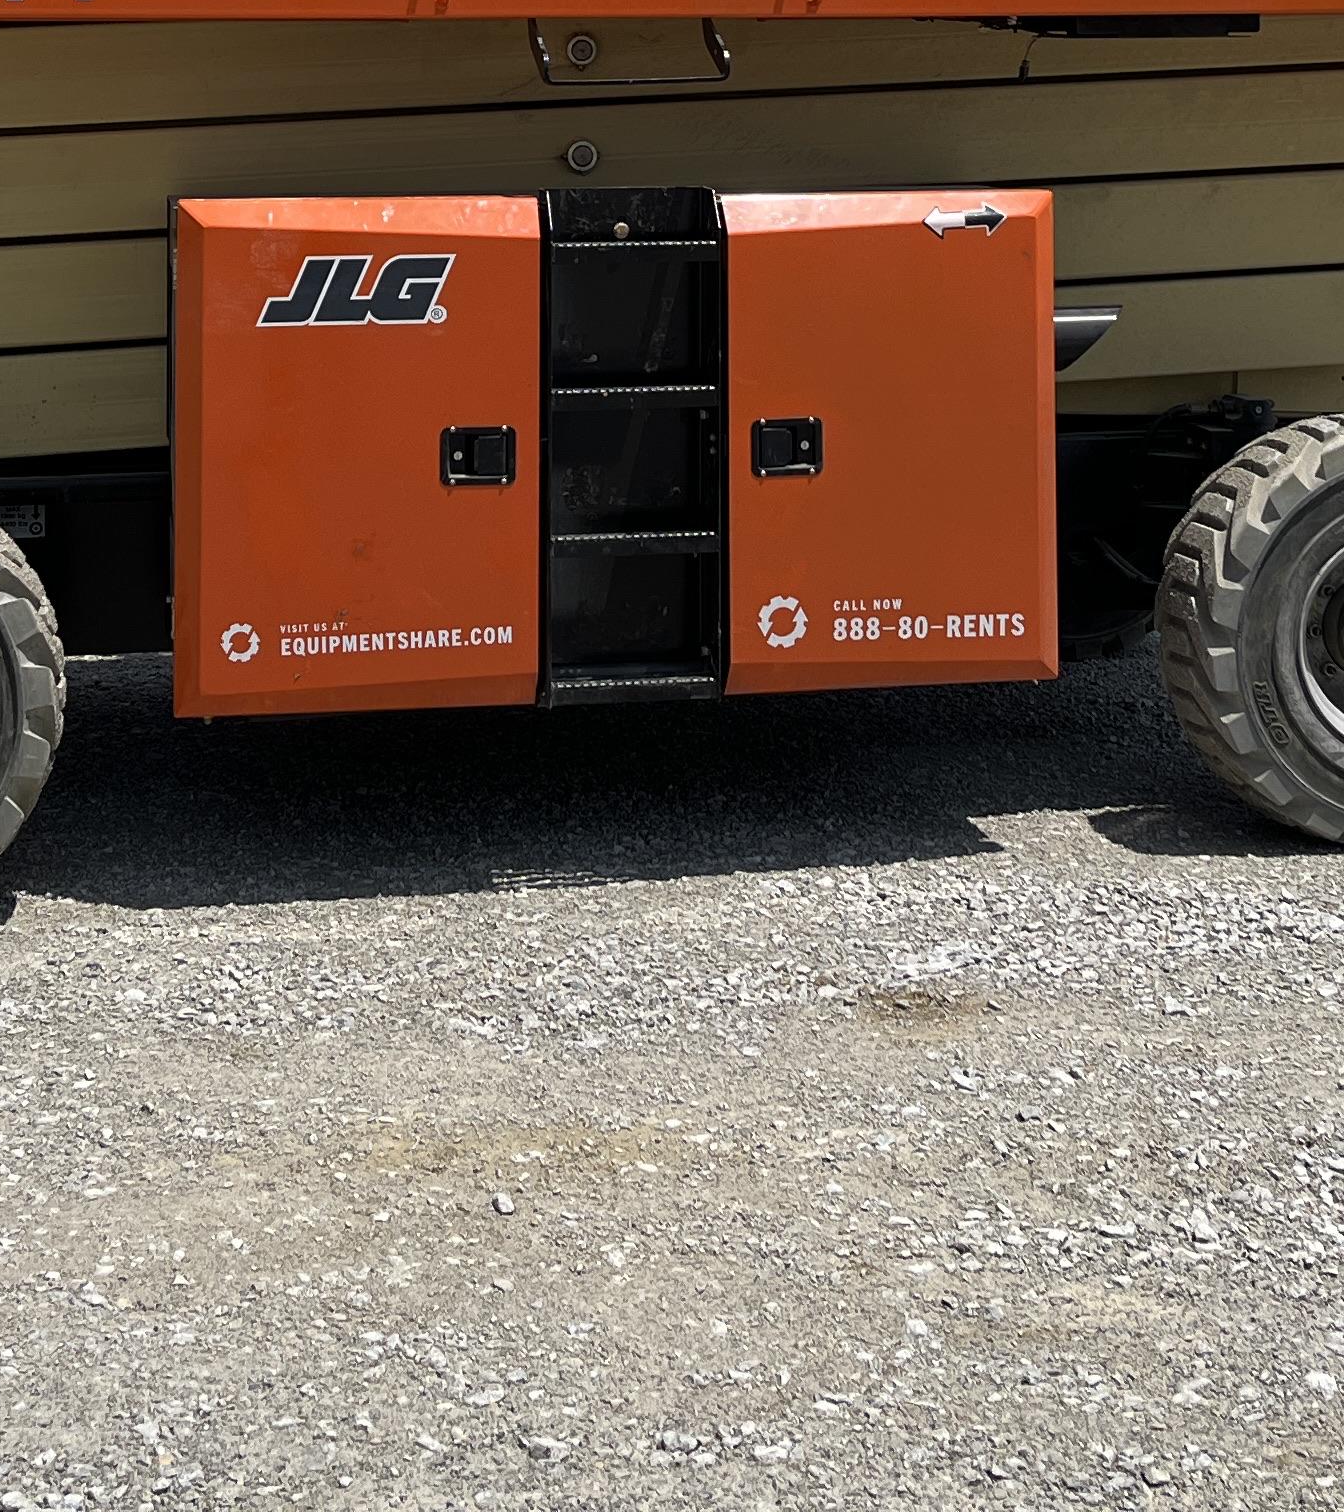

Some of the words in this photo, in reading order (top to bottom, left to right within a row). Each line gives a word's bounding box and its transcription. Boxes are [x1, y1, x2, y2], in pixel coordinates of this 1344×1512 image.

[256, 254, 456, 327] JLG
[833, 600, 867, 611] CALL
[873, 598, 903, 610] NOW
[279, 624, 309, 634] VISIT
[313, 622, 328, 632] US
[833, 613, 1026, 641] 888-80-RENTS
[280, 626, 514, 657] EQUIPMENTSHARE.COM
